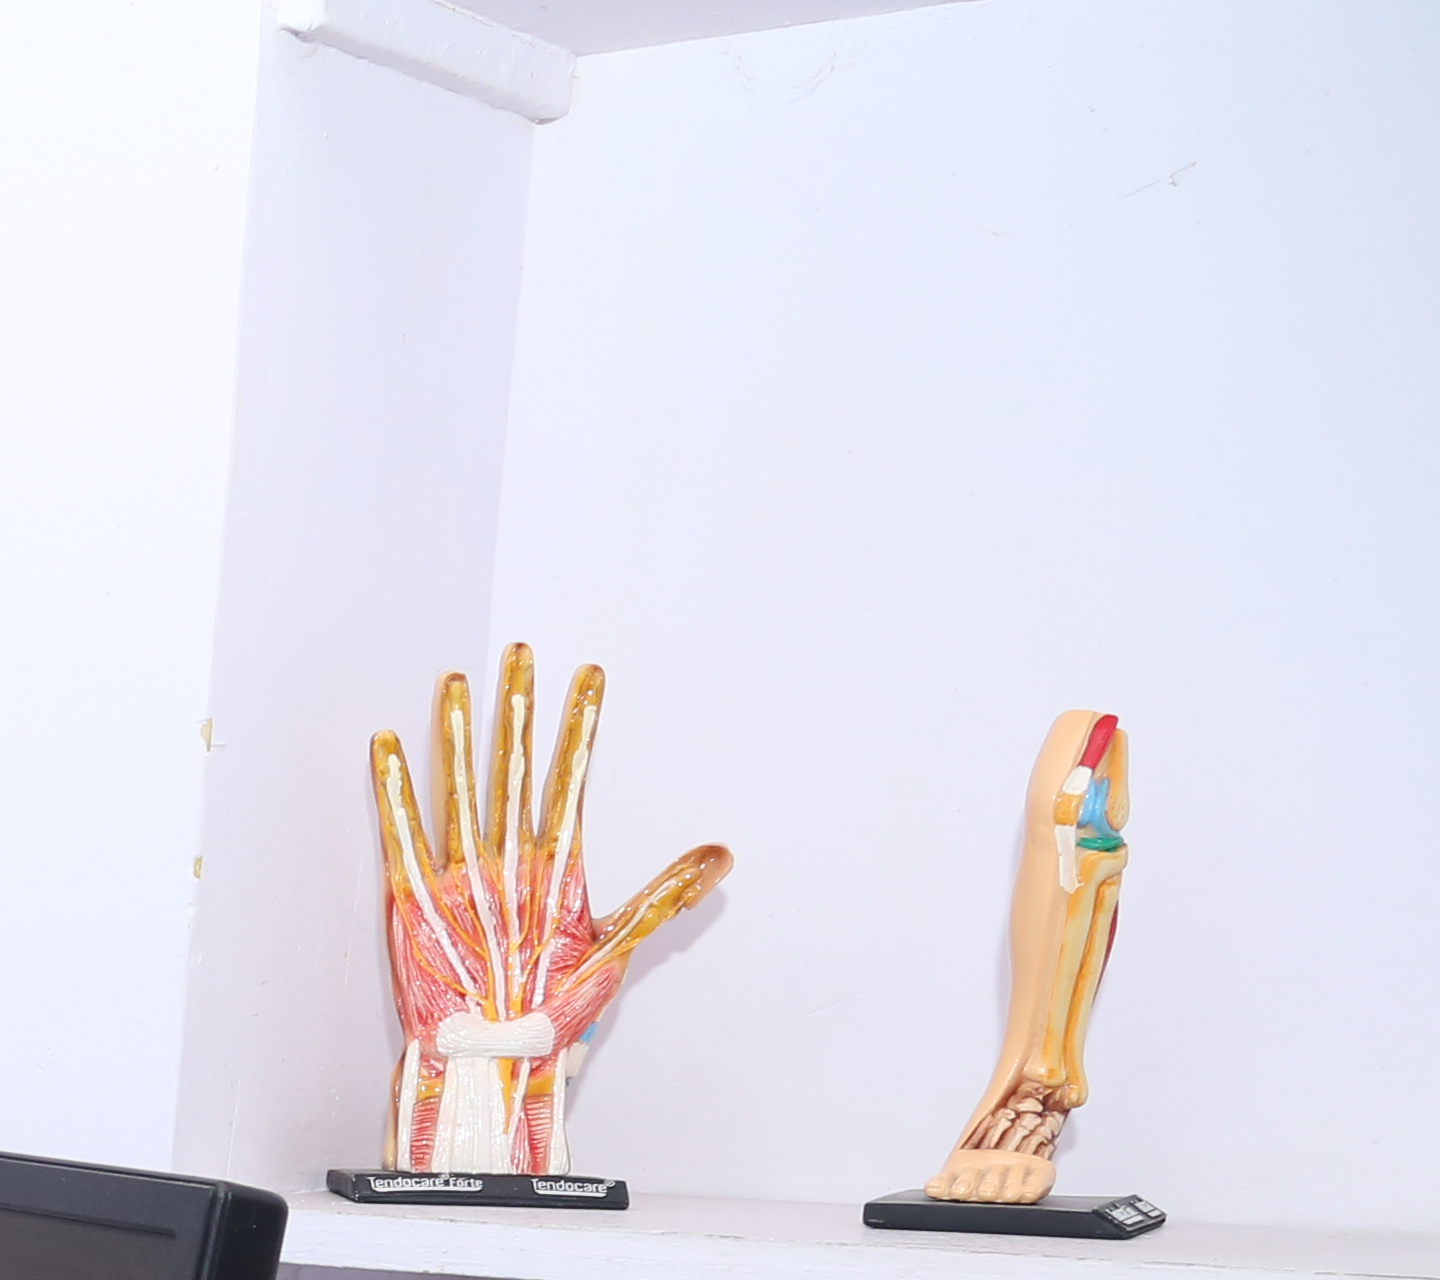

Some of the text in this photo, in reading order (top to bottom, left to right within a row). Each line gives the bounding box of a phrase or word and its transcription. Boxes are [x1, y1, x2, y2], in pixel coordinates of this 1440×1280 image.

[367, 1175, 483, 1189] Tendocare Forte
[531, 1178, 607, 1193] Tendocare
